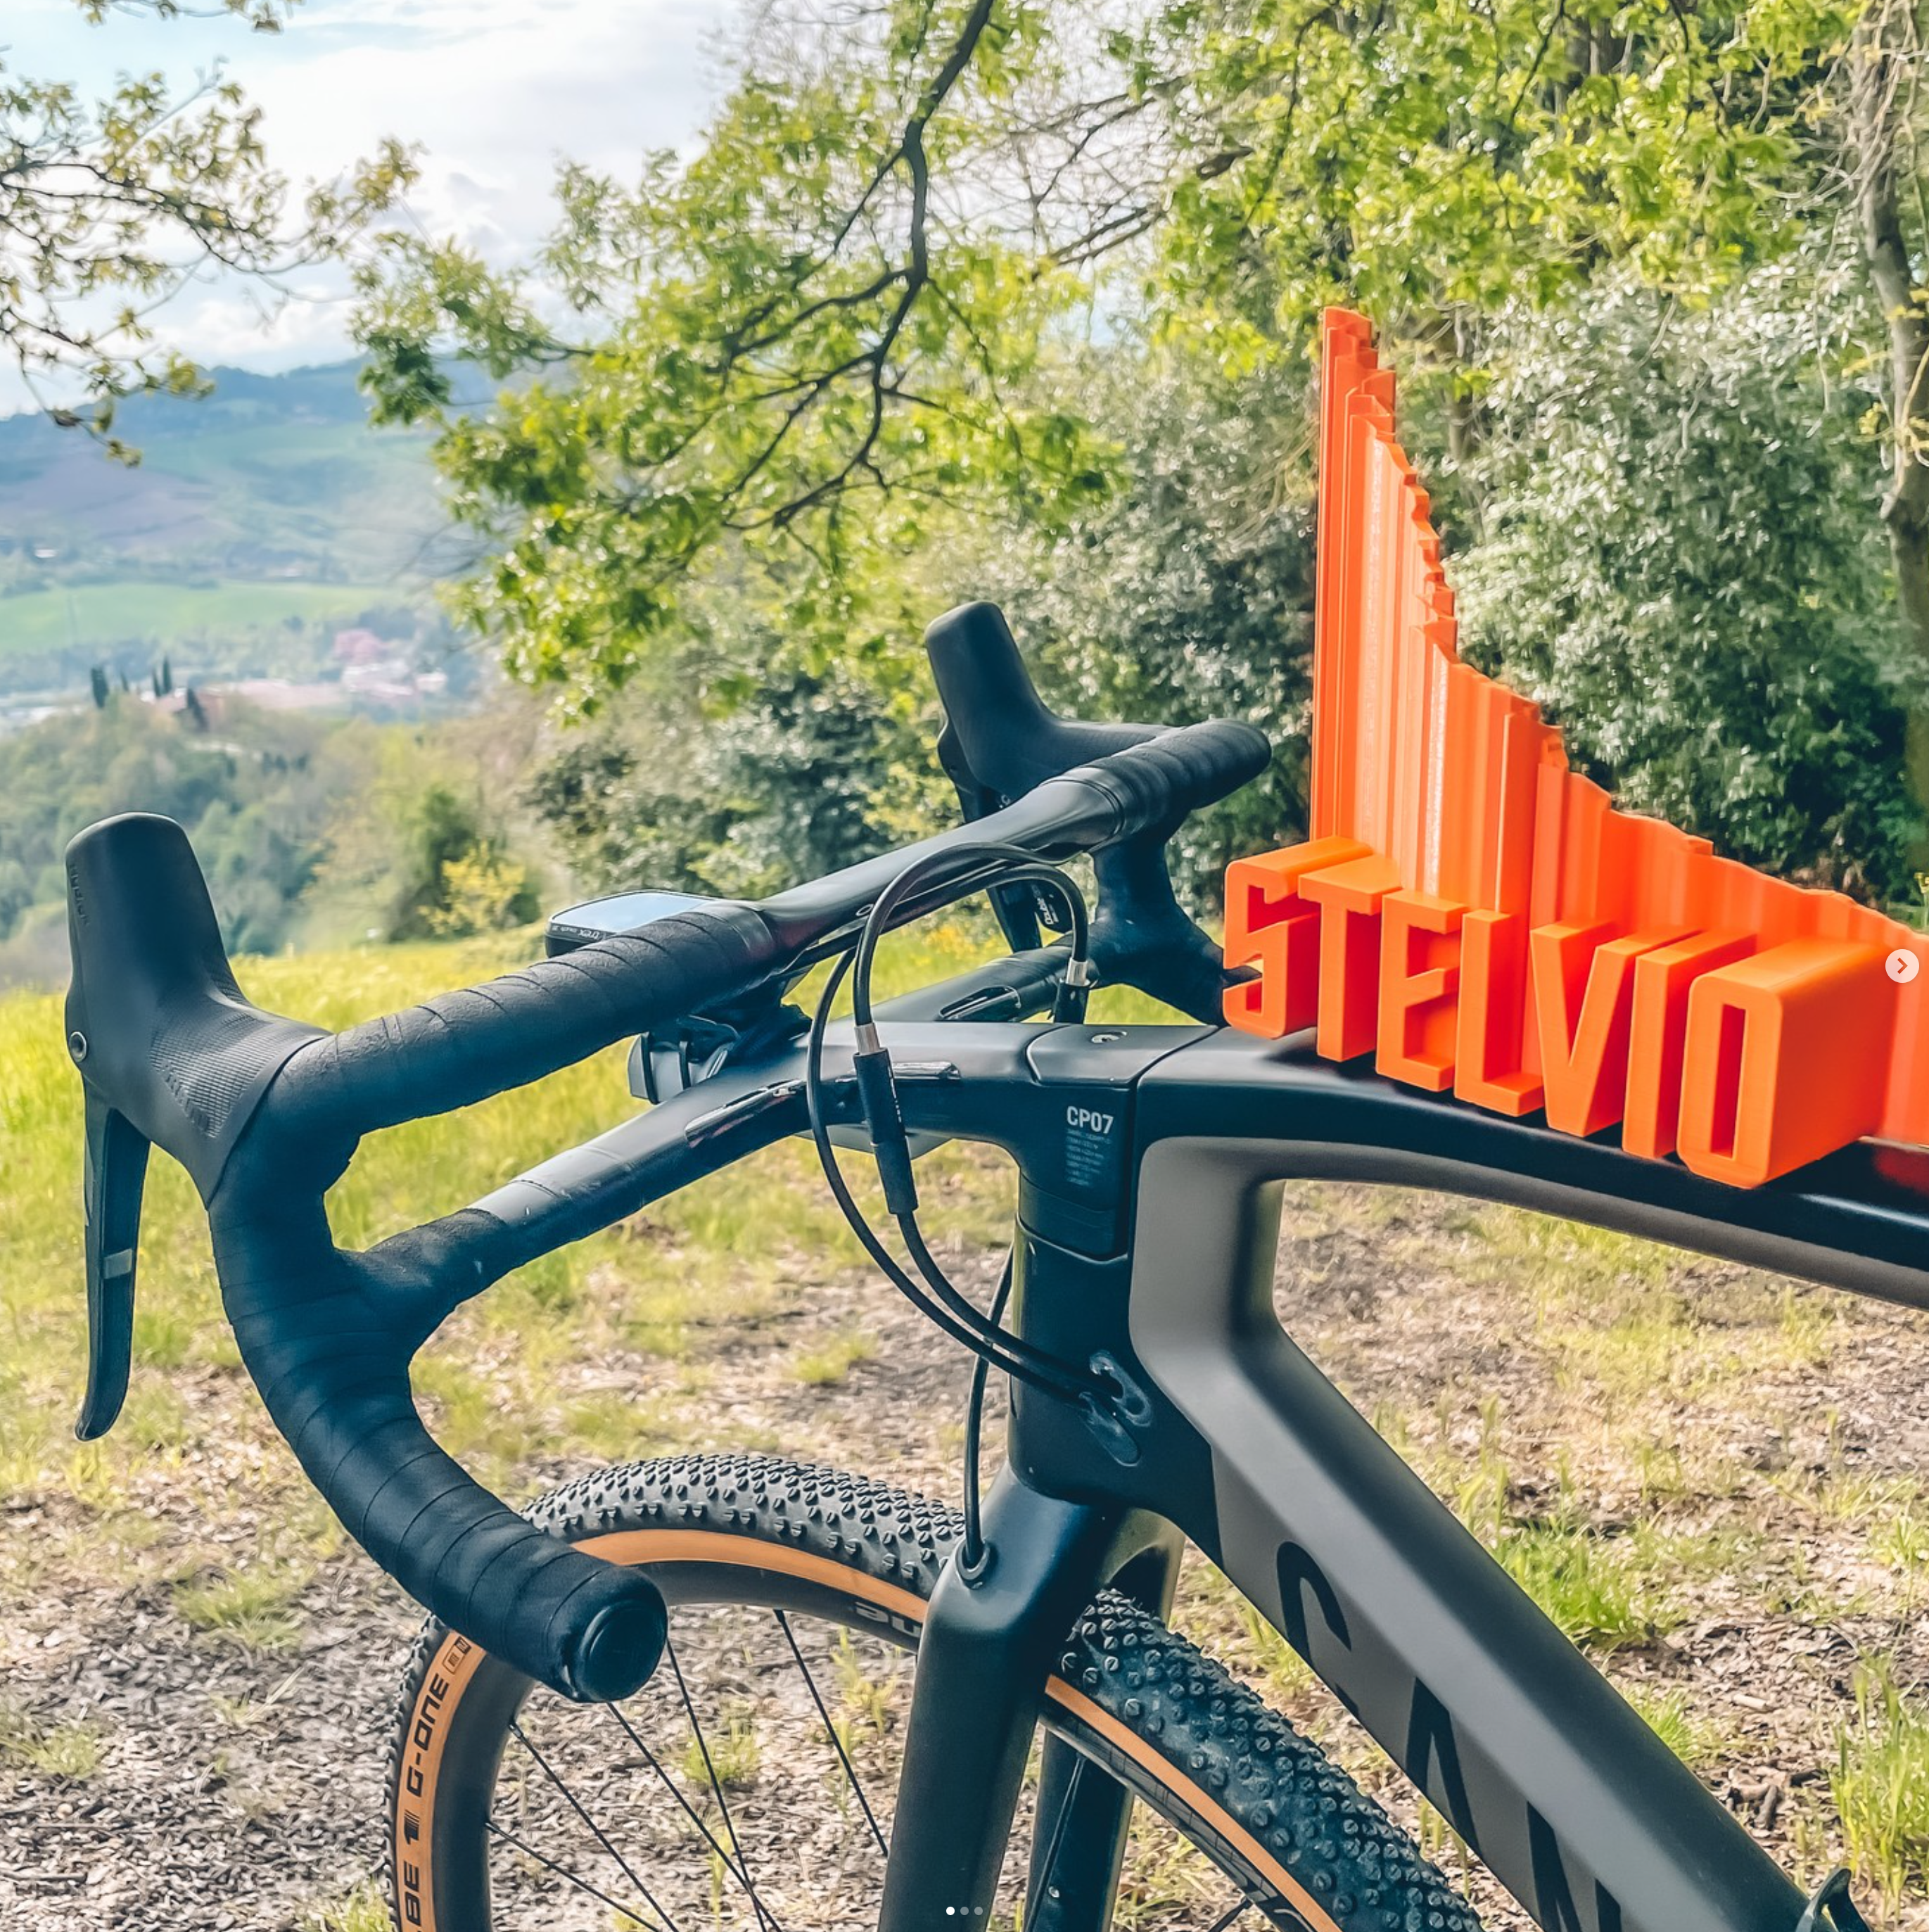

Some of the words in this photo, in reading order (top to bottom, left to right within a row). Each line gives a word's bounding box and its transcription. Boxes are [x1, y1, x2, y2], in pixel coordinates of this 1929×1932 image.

[1223, 839, 1790, 1189] STELVIO
[1066, 1105, 1114, 1134] CP07
[406, 1672, 450, 1798] G-ONE
[404, 1860, 423, 1932] BE
